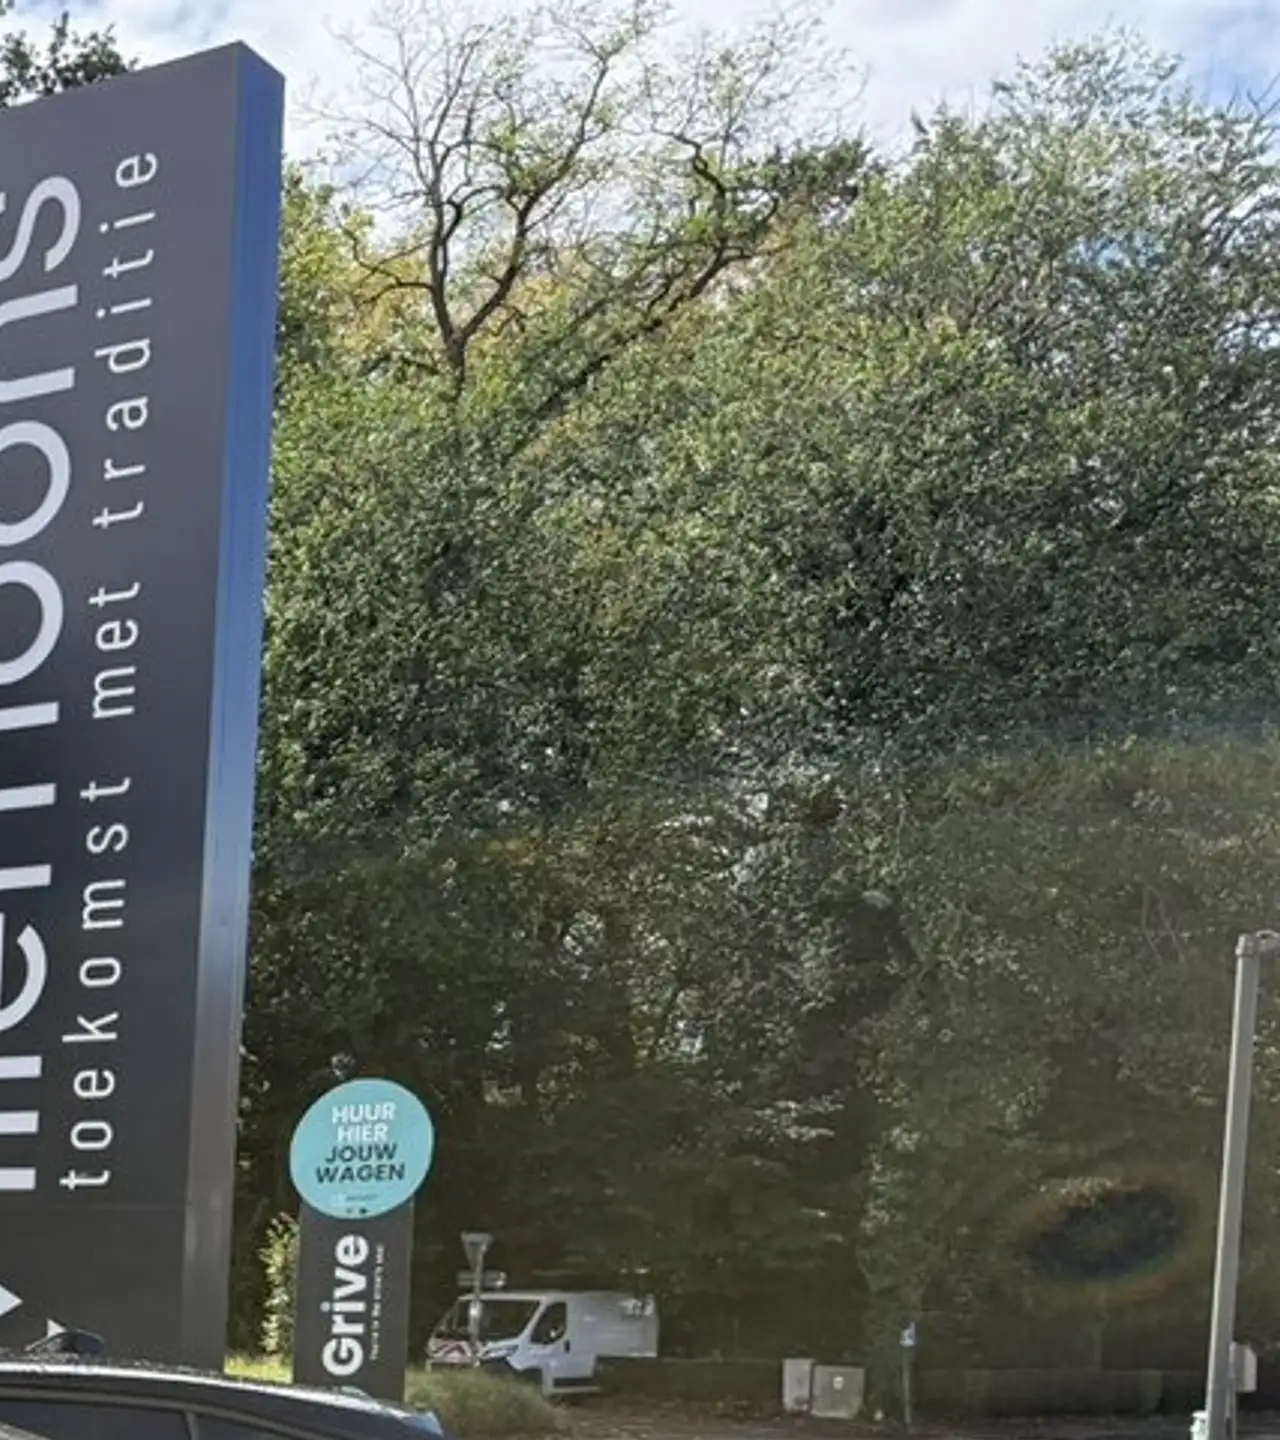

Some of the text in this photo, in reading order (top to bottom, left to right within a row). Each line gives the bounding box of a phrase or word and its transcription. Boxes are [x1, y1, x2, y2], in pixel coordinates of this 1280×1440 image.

[59, 151, 160, 1191] toekomst met traditie
[331, 1102, 396, 1124] HUUR
[337, 1122, 388, 1143] HIER
[325, 1142, 397, 1164] JOUW
[316, 1162, 406, 1184] WAGEN
[321, 1233, 370, 1377] Grive
